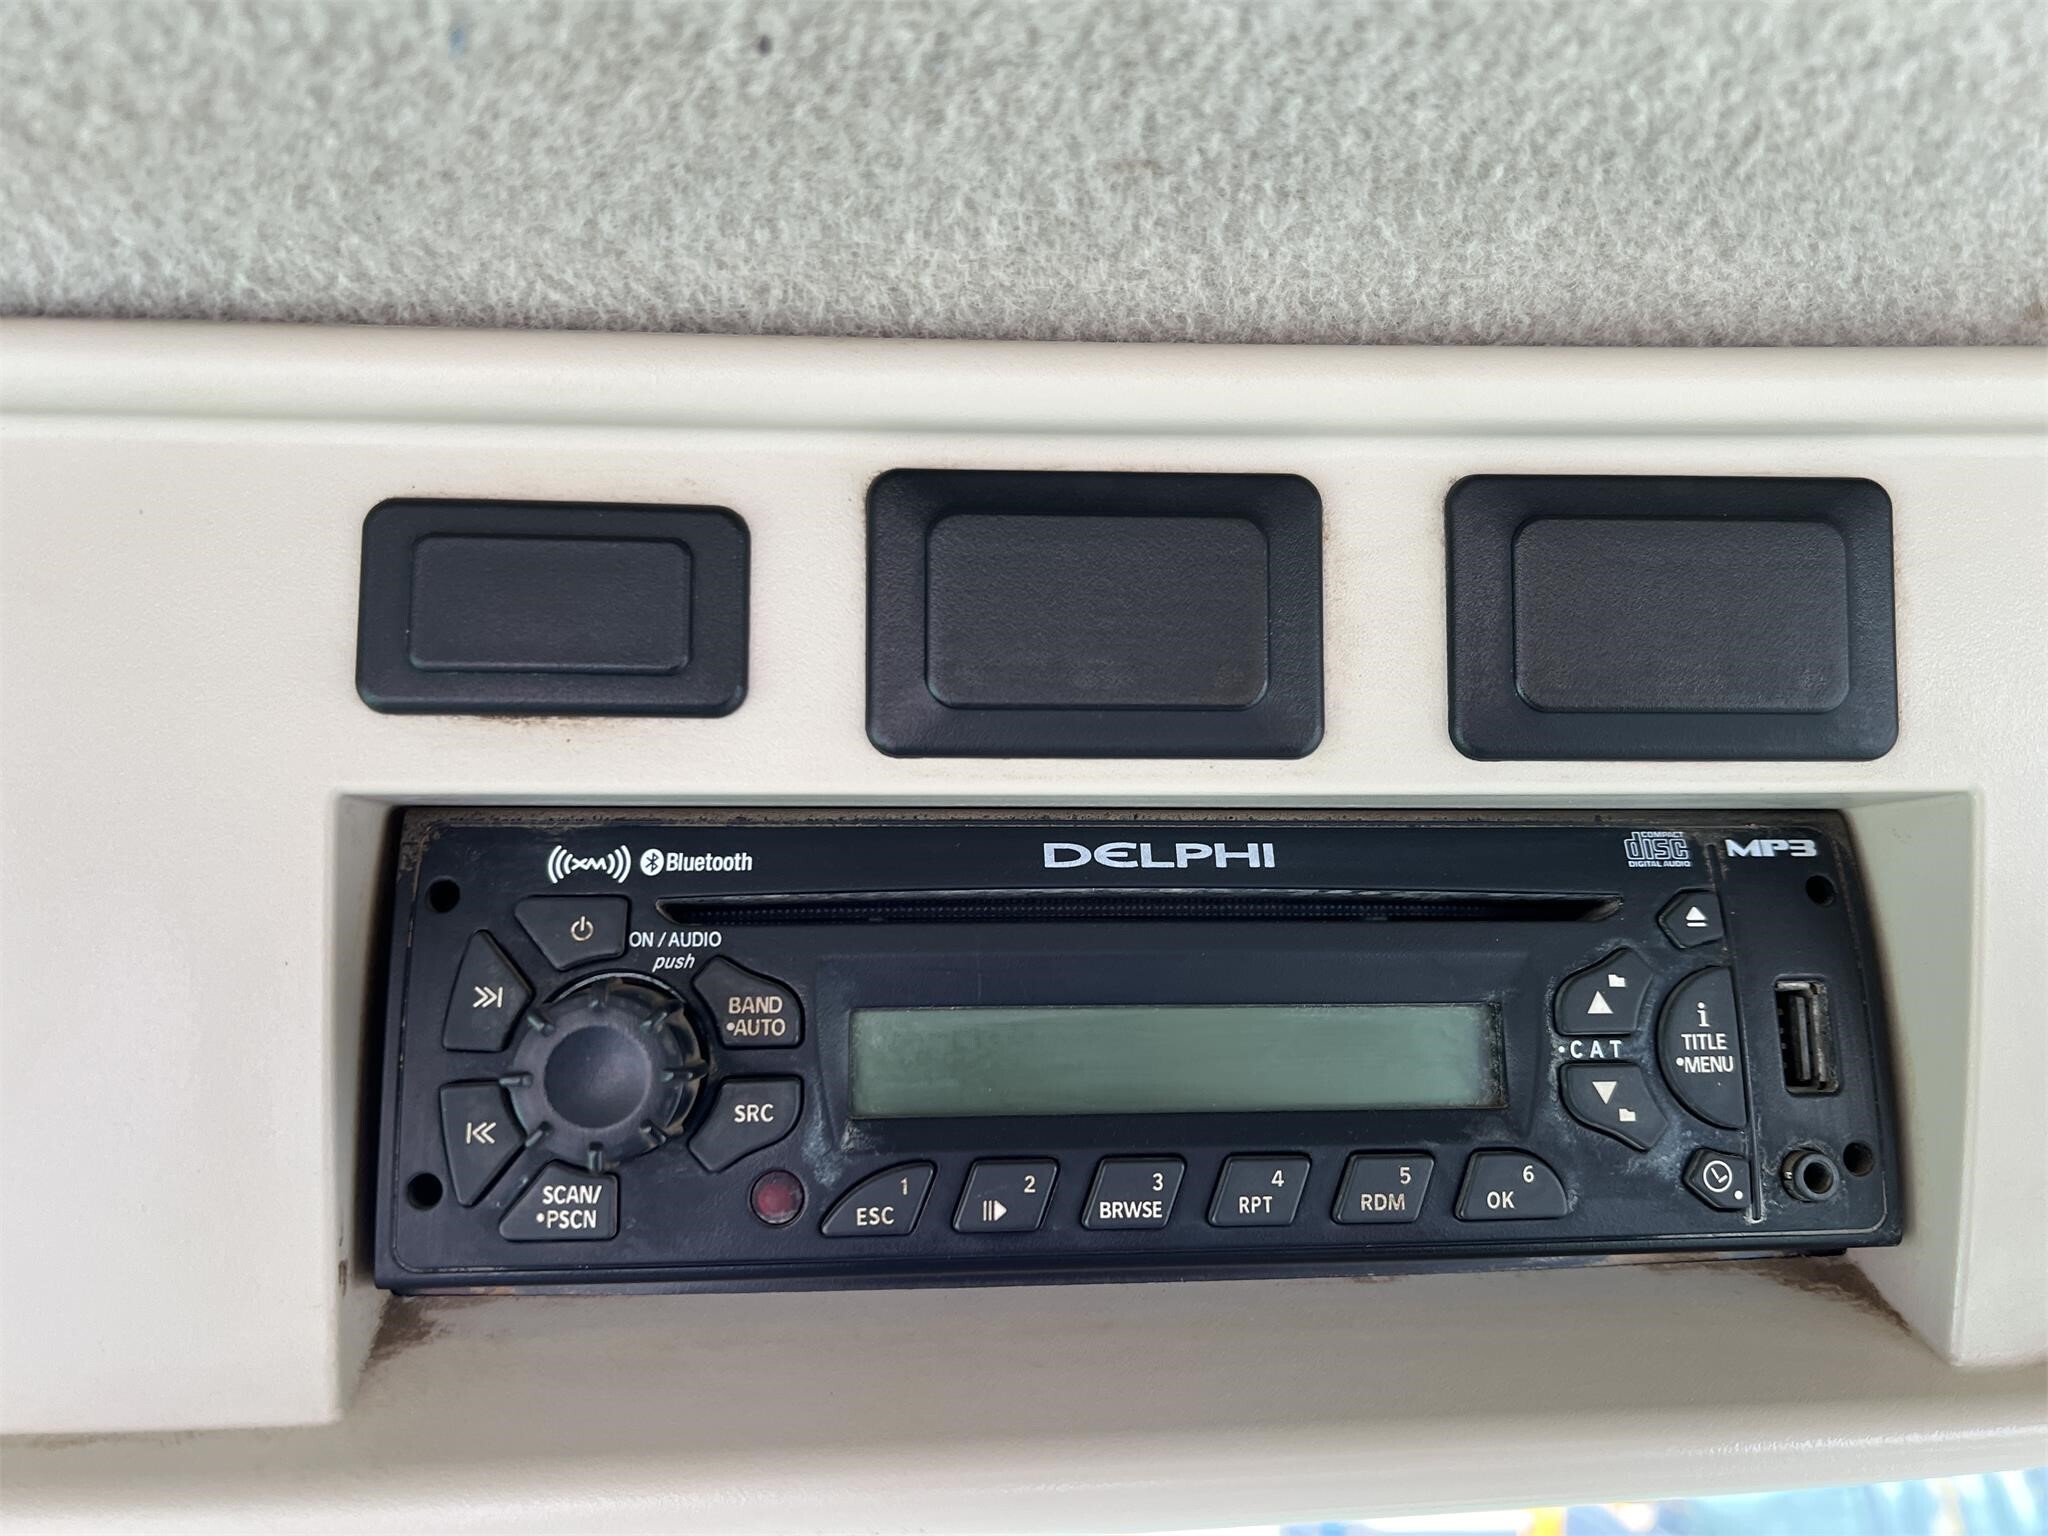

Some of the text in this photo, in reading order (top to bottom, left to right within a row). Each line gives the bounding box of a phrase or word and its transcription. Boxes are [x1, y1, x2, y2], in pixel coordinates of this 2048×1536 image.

[1043, 842, 1276, 868] DELPHI
[1724, 839, 1818, 857] MP3
[666, 852, 753, 872] Bluetooth
[1628, 860, 1692, 868] DIGITAL AUDIO
[629, 931, 654, 948] ON
[668, 931, 722, 948] AUDIO
[652, 953, 696, 972] push
[728, 995, 783, 1014] BAND
[1681, 1033, 1728, 1051] TITLE
[734, 1104, 774, 1123] SRC
[1152, 1173, 1164, 1192] 3
[1271, 1169, 1285, 1187] 4
[1400, 1166, 1412, 1185] 5
[1523, 1166, 1534, 1183] 6
[900, 1178, 908, 1196] 1
[1024, 1175, 1036, 1193] 2
[542, 1184, 602, 1205] SCAN/
[1360, 1193, 1406, 1211] RDM
[1487, 1191, 1515, 1209] OK
[1099, 1201, 1163, 1219] BRWSE
[1239, 1196, 1273, 1214] RPT
[856, 1206, 895, 1226] ESC
